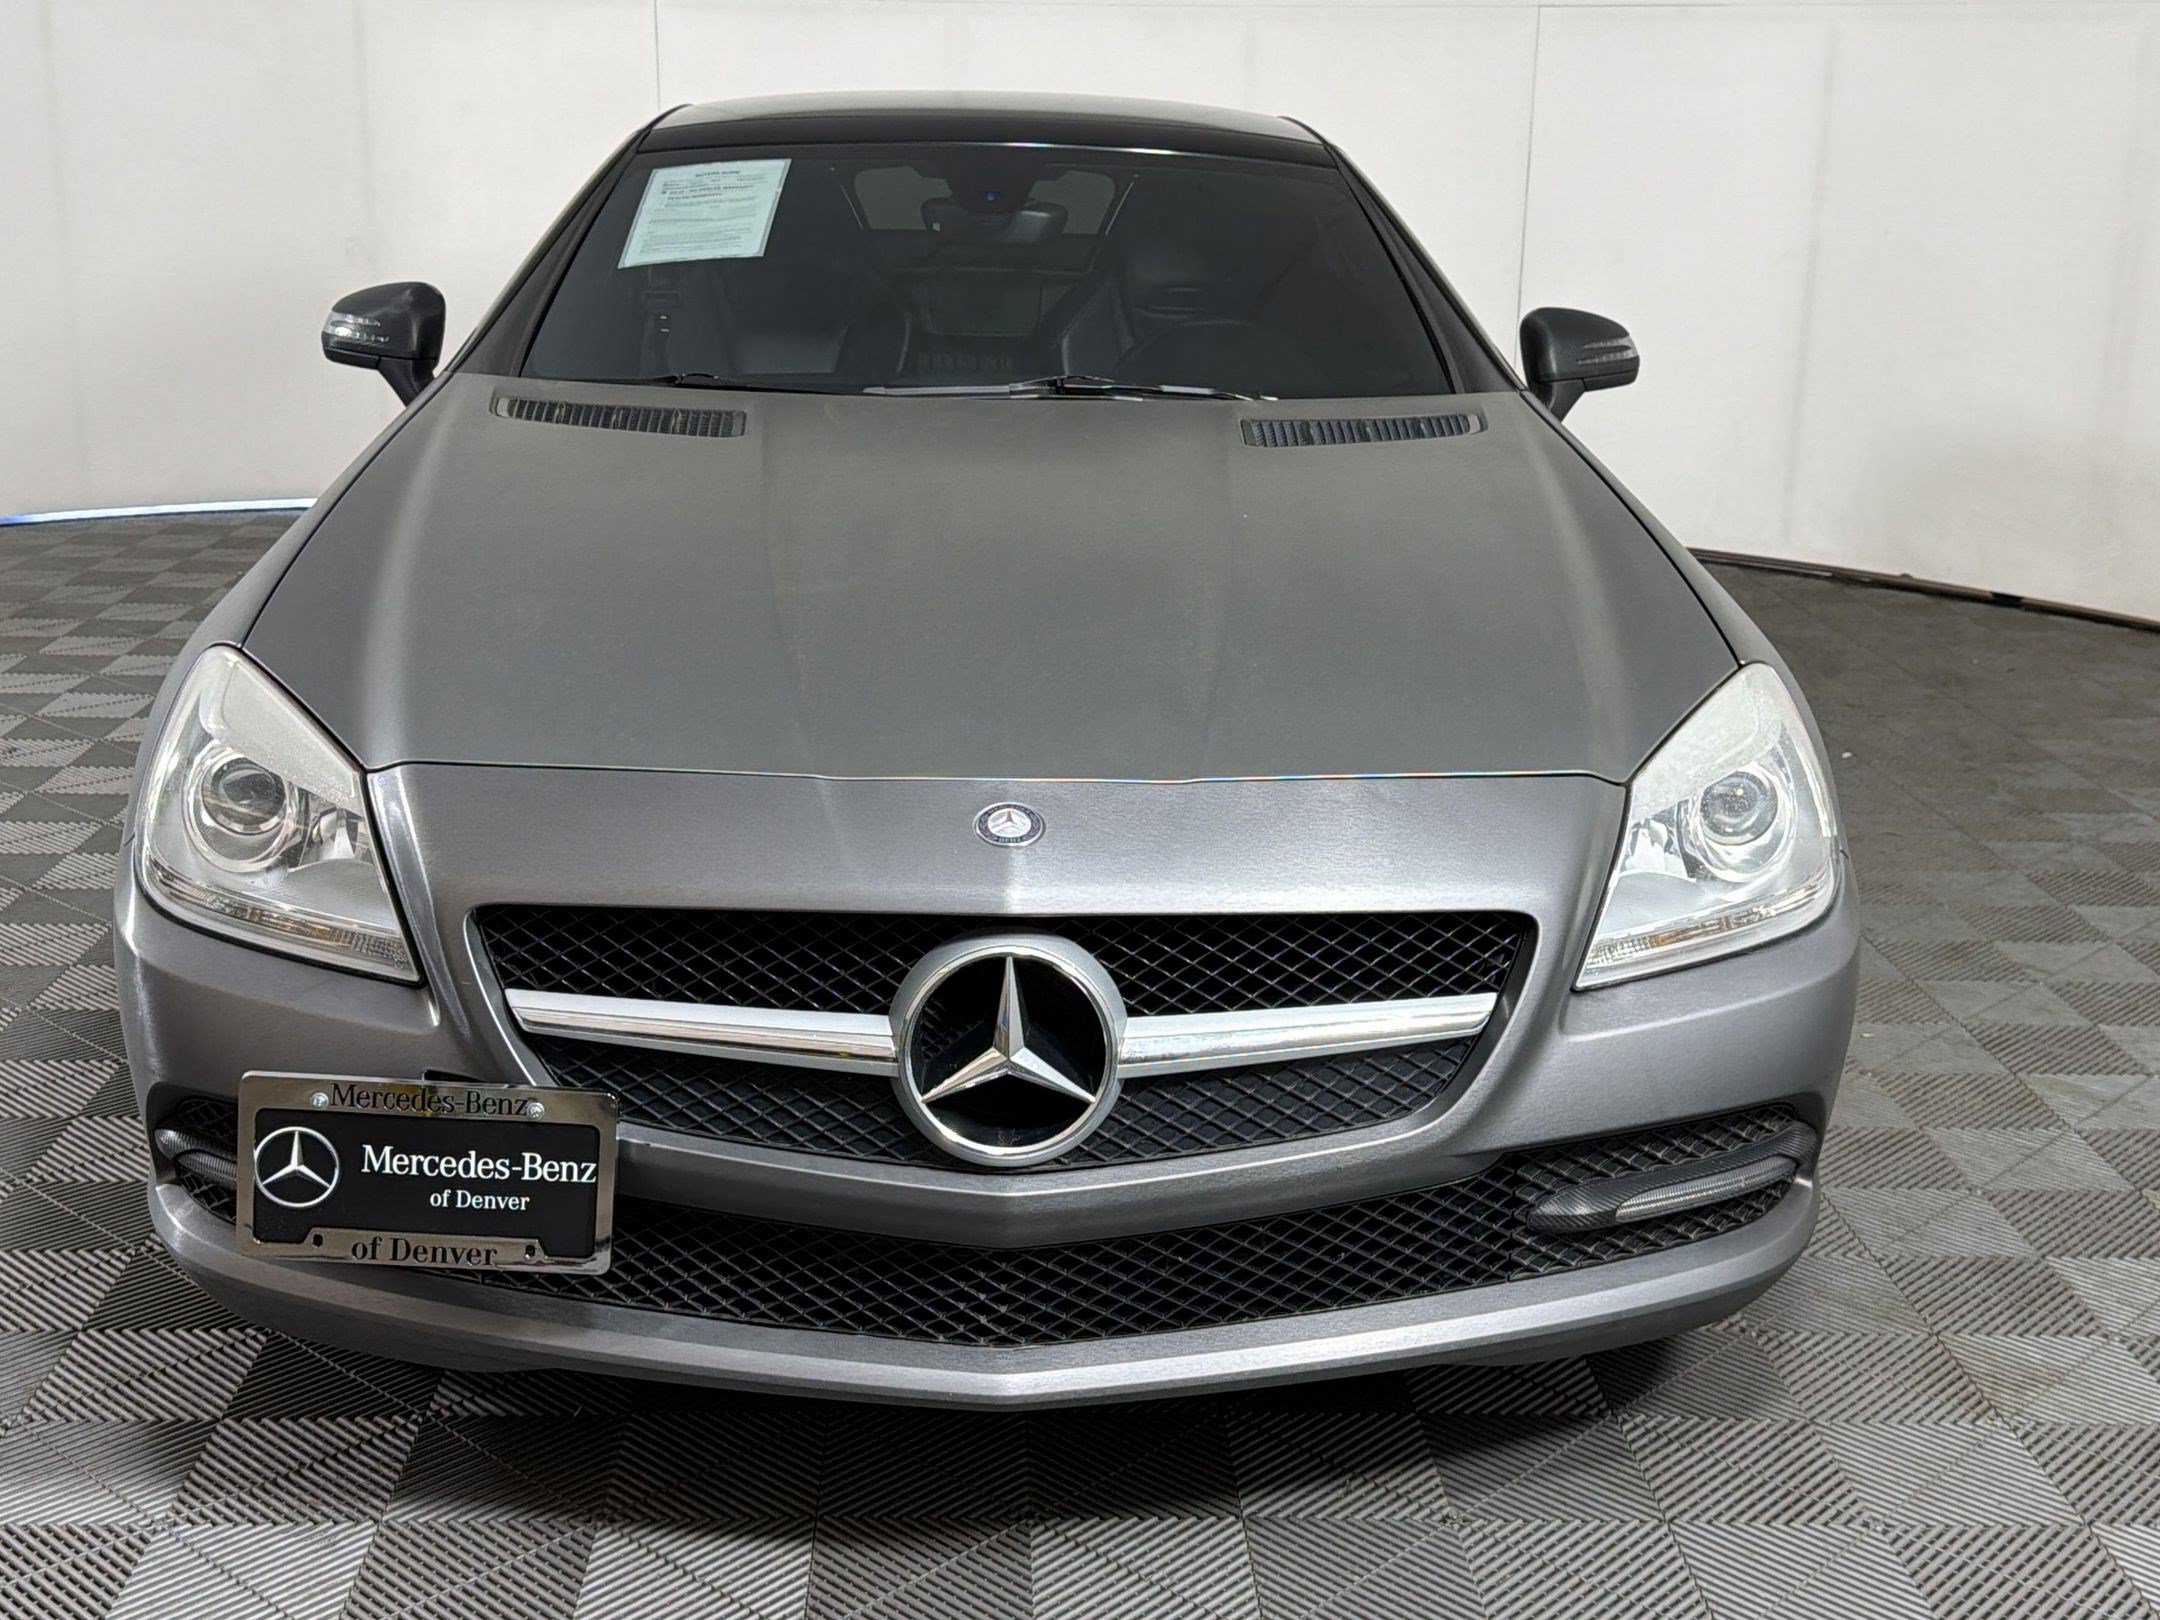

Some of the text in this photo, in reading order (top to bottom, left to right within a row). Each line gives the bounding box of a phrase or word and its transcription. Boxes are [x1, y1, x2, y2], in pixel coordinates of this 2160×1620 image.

[330, 1083, 527, 1115] Mercedes-Benz
[361, 1144, 597, 1183] Mercedes-Benz
[429, 1189, 530, 1211] of Denver
[351, 1236, 497, 1265] of Denver
